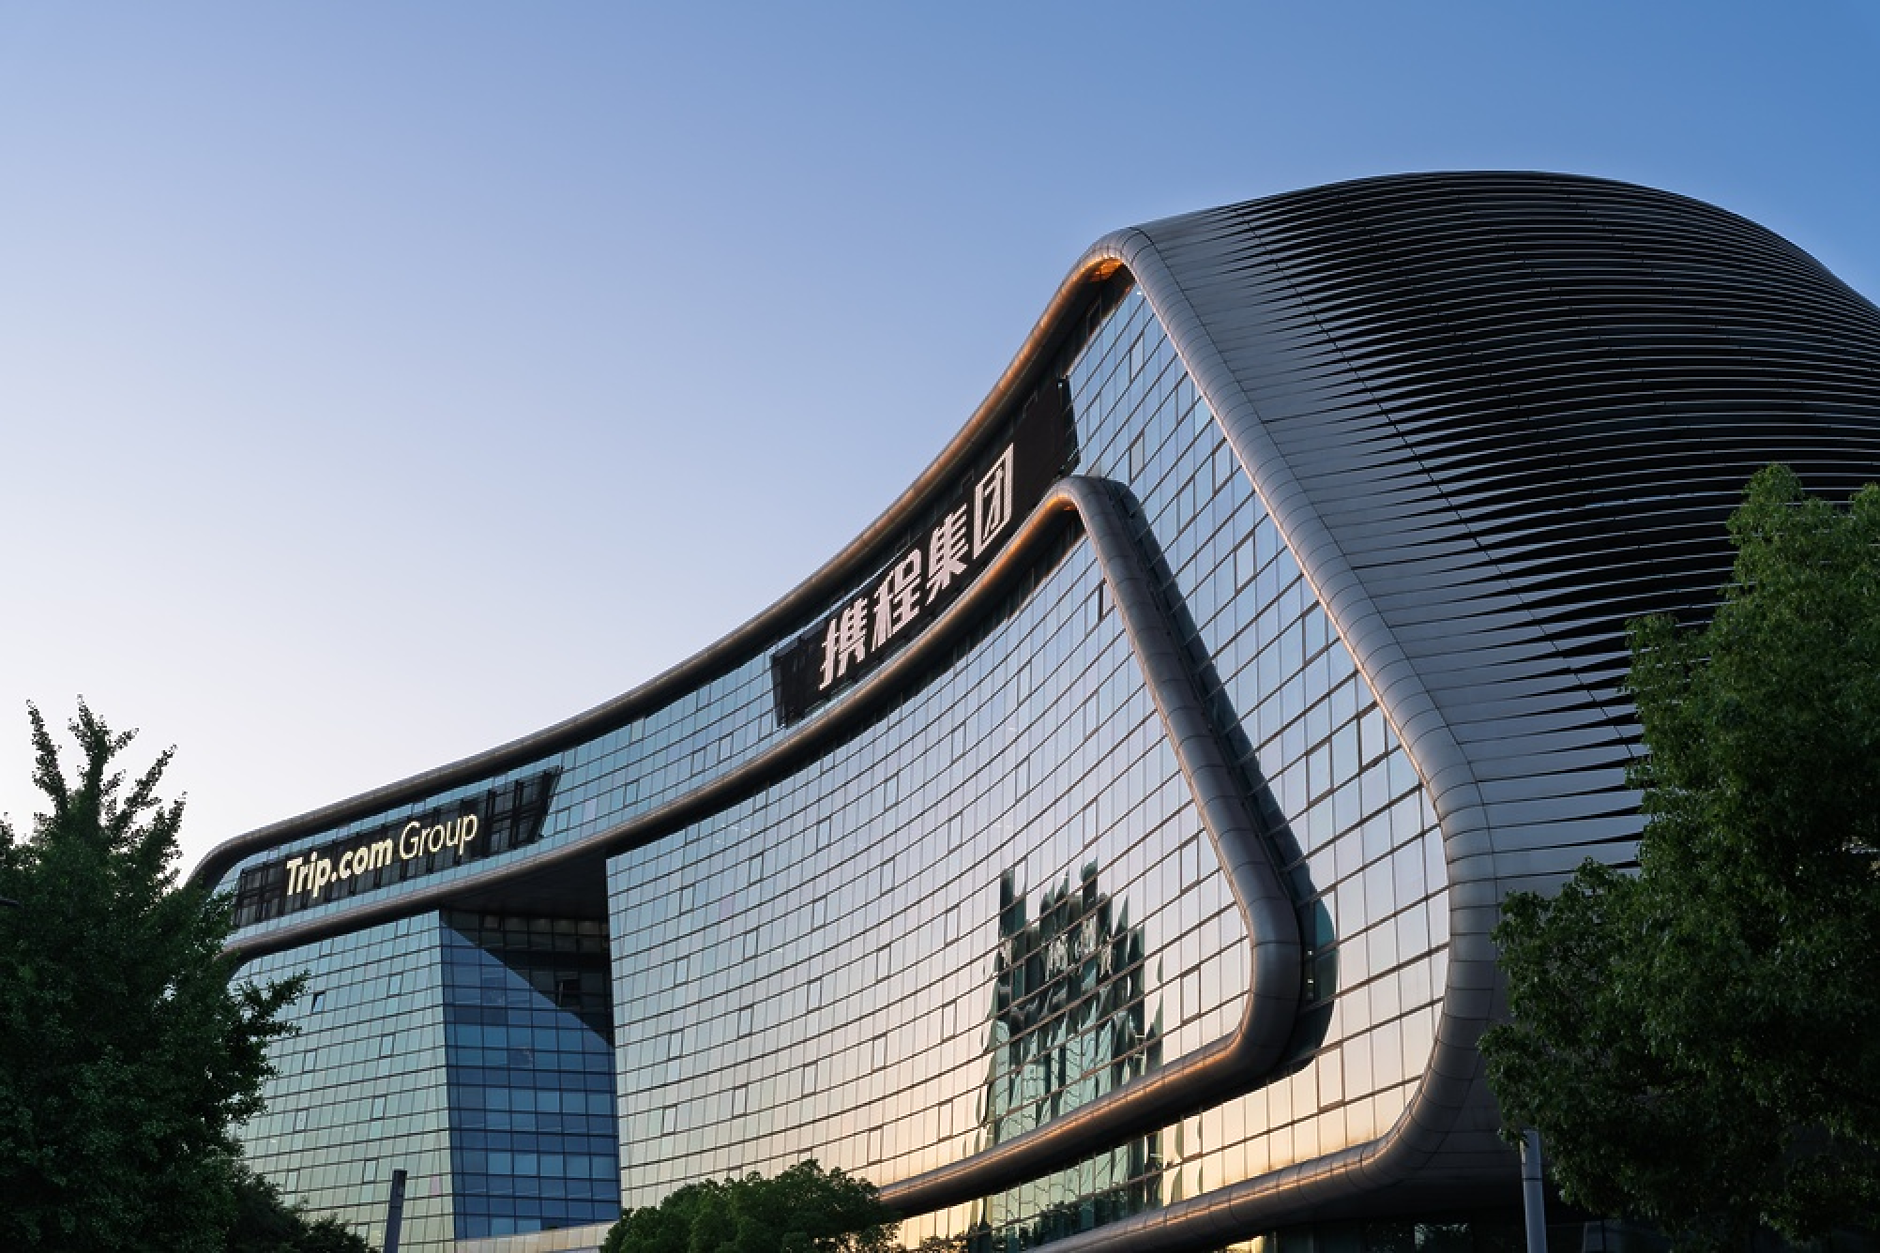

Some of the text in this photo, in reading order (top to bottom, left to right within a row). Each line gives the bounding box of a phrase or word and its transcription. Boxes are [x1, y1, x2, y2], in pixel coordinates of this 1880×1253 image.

[819, 442, 1014, 691] 携程集团
[286, 813, 478, 898] Trip.com Group
